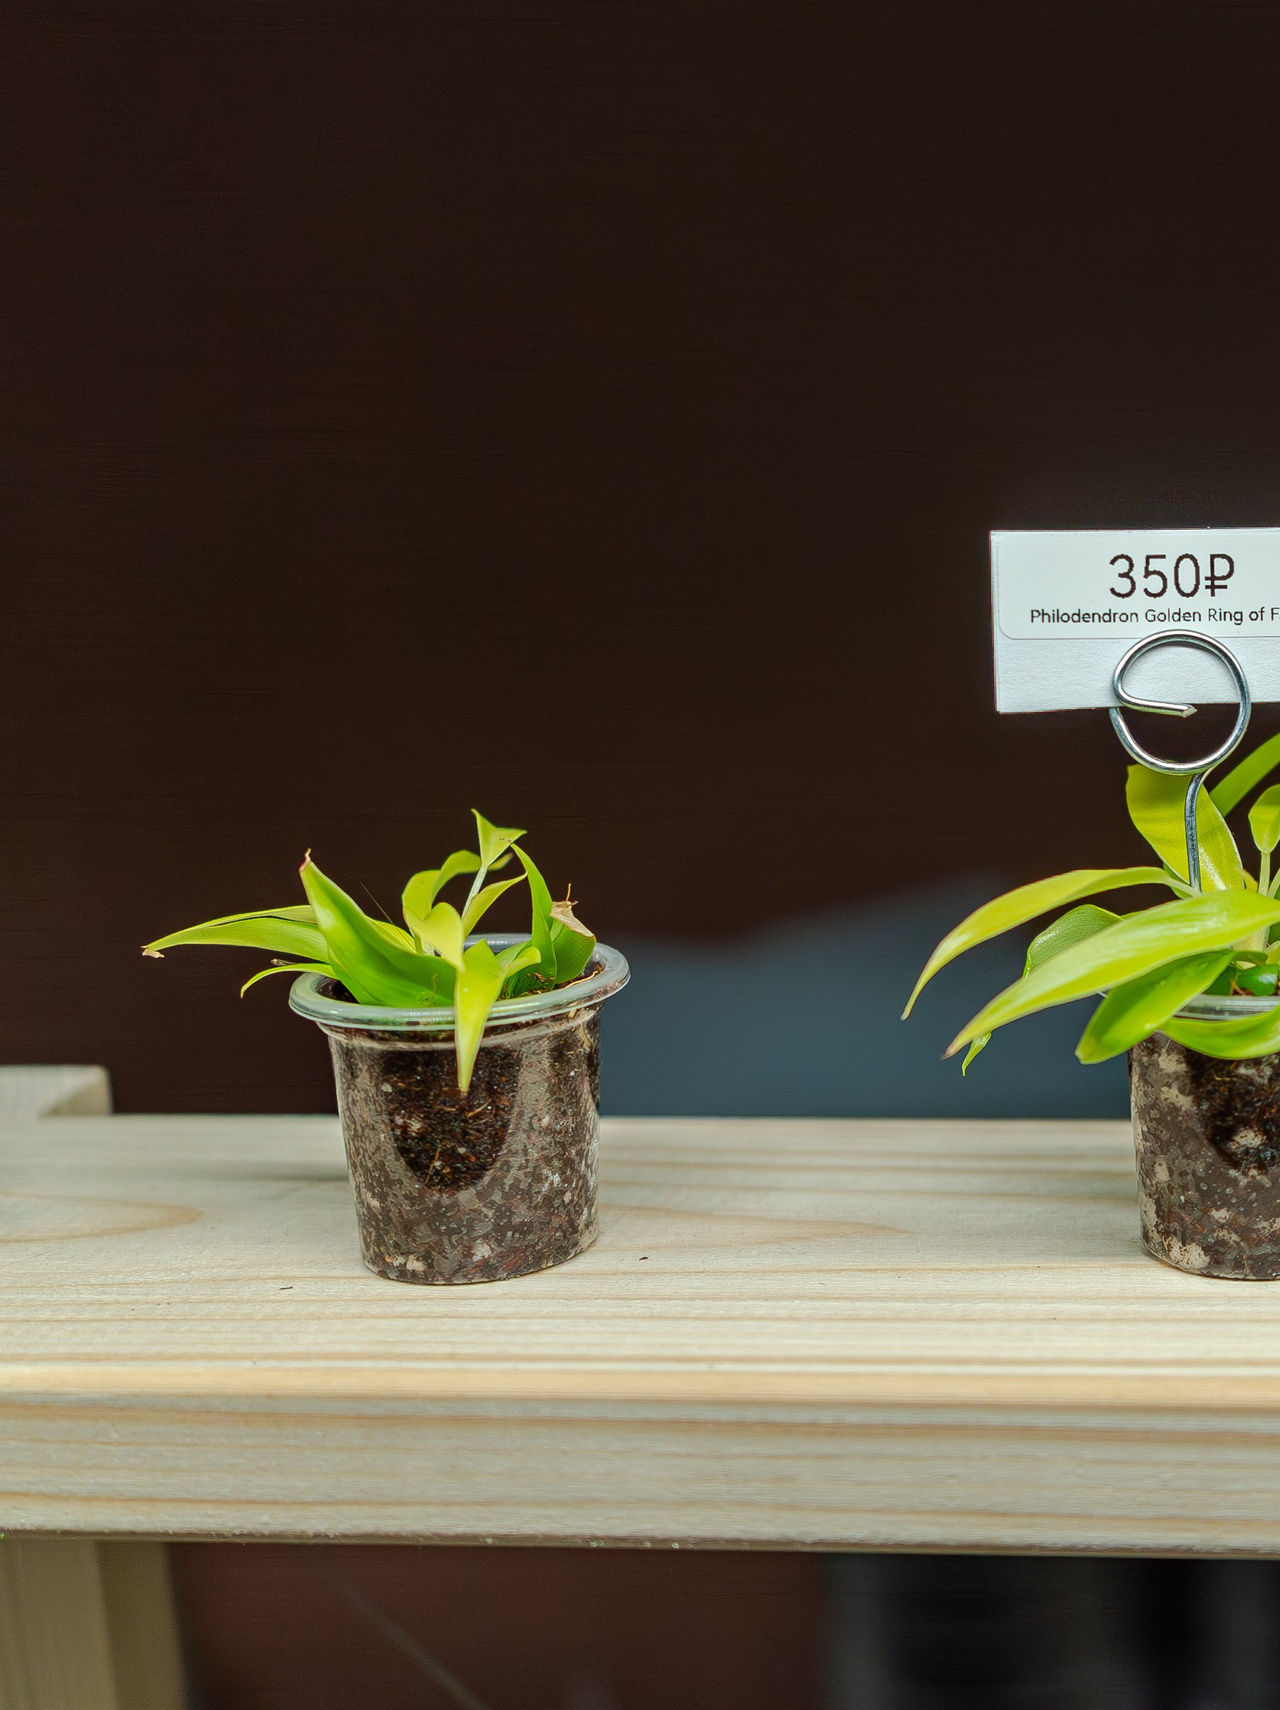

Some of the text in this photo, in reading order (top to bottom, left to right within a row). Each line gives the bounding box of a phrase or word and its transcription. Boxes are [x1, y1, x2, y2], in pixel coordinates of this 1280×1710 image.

[1108, 552, 1235, 599] 350₽
[1030, 608, 1139, 624] Philodendron
[1144, 607, 1202, 623] Golden
[1208, 607, 1244, 626] Ring
[1248, 606, 1266, 622] of
